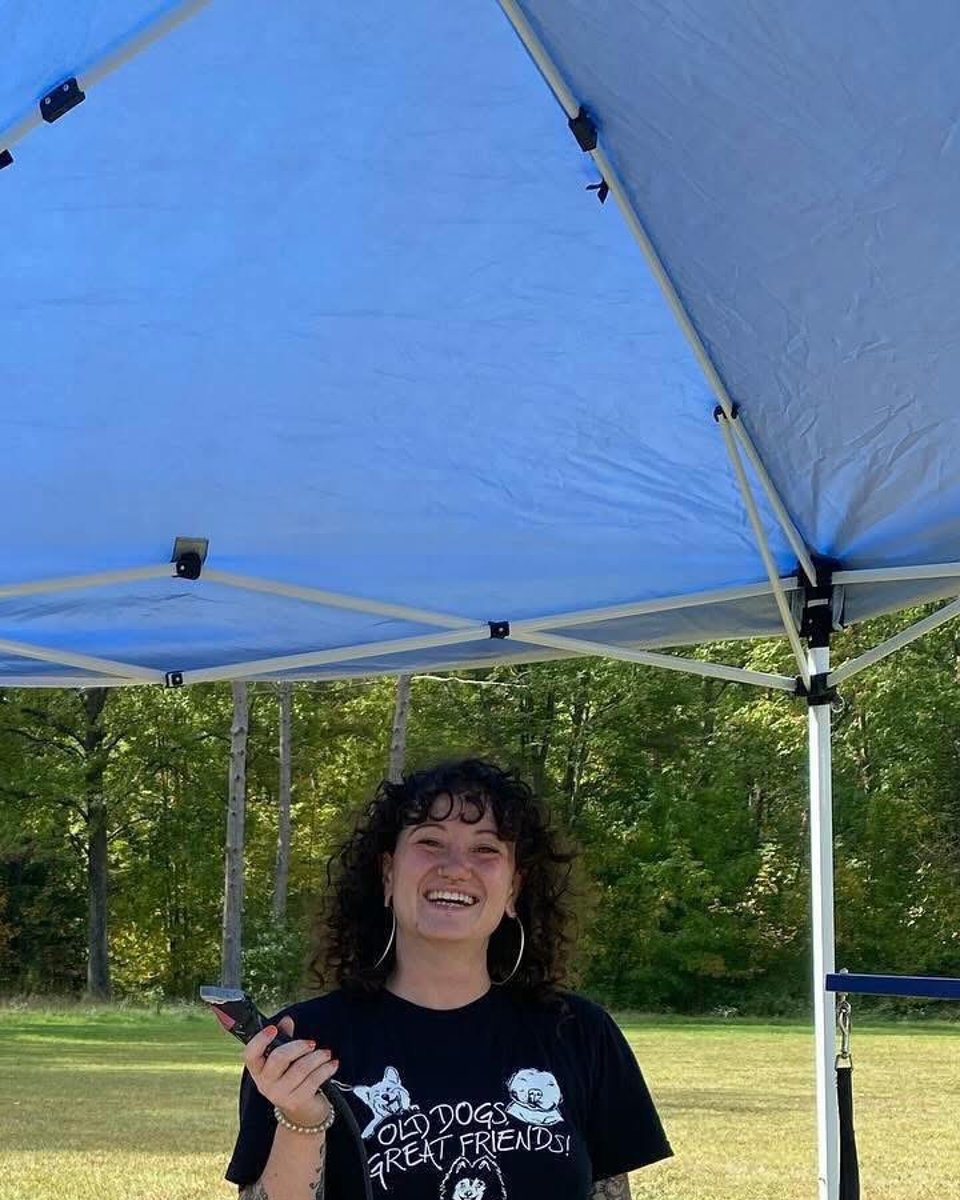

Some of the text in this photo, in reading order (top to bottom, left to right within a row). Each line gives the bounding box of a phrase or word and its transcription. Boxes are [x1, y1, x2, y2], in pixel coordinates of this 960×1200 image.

[377, 1113, 430, 1146] OLD
[367, 1125, 571, 1191] GREAT FRIENDS!
